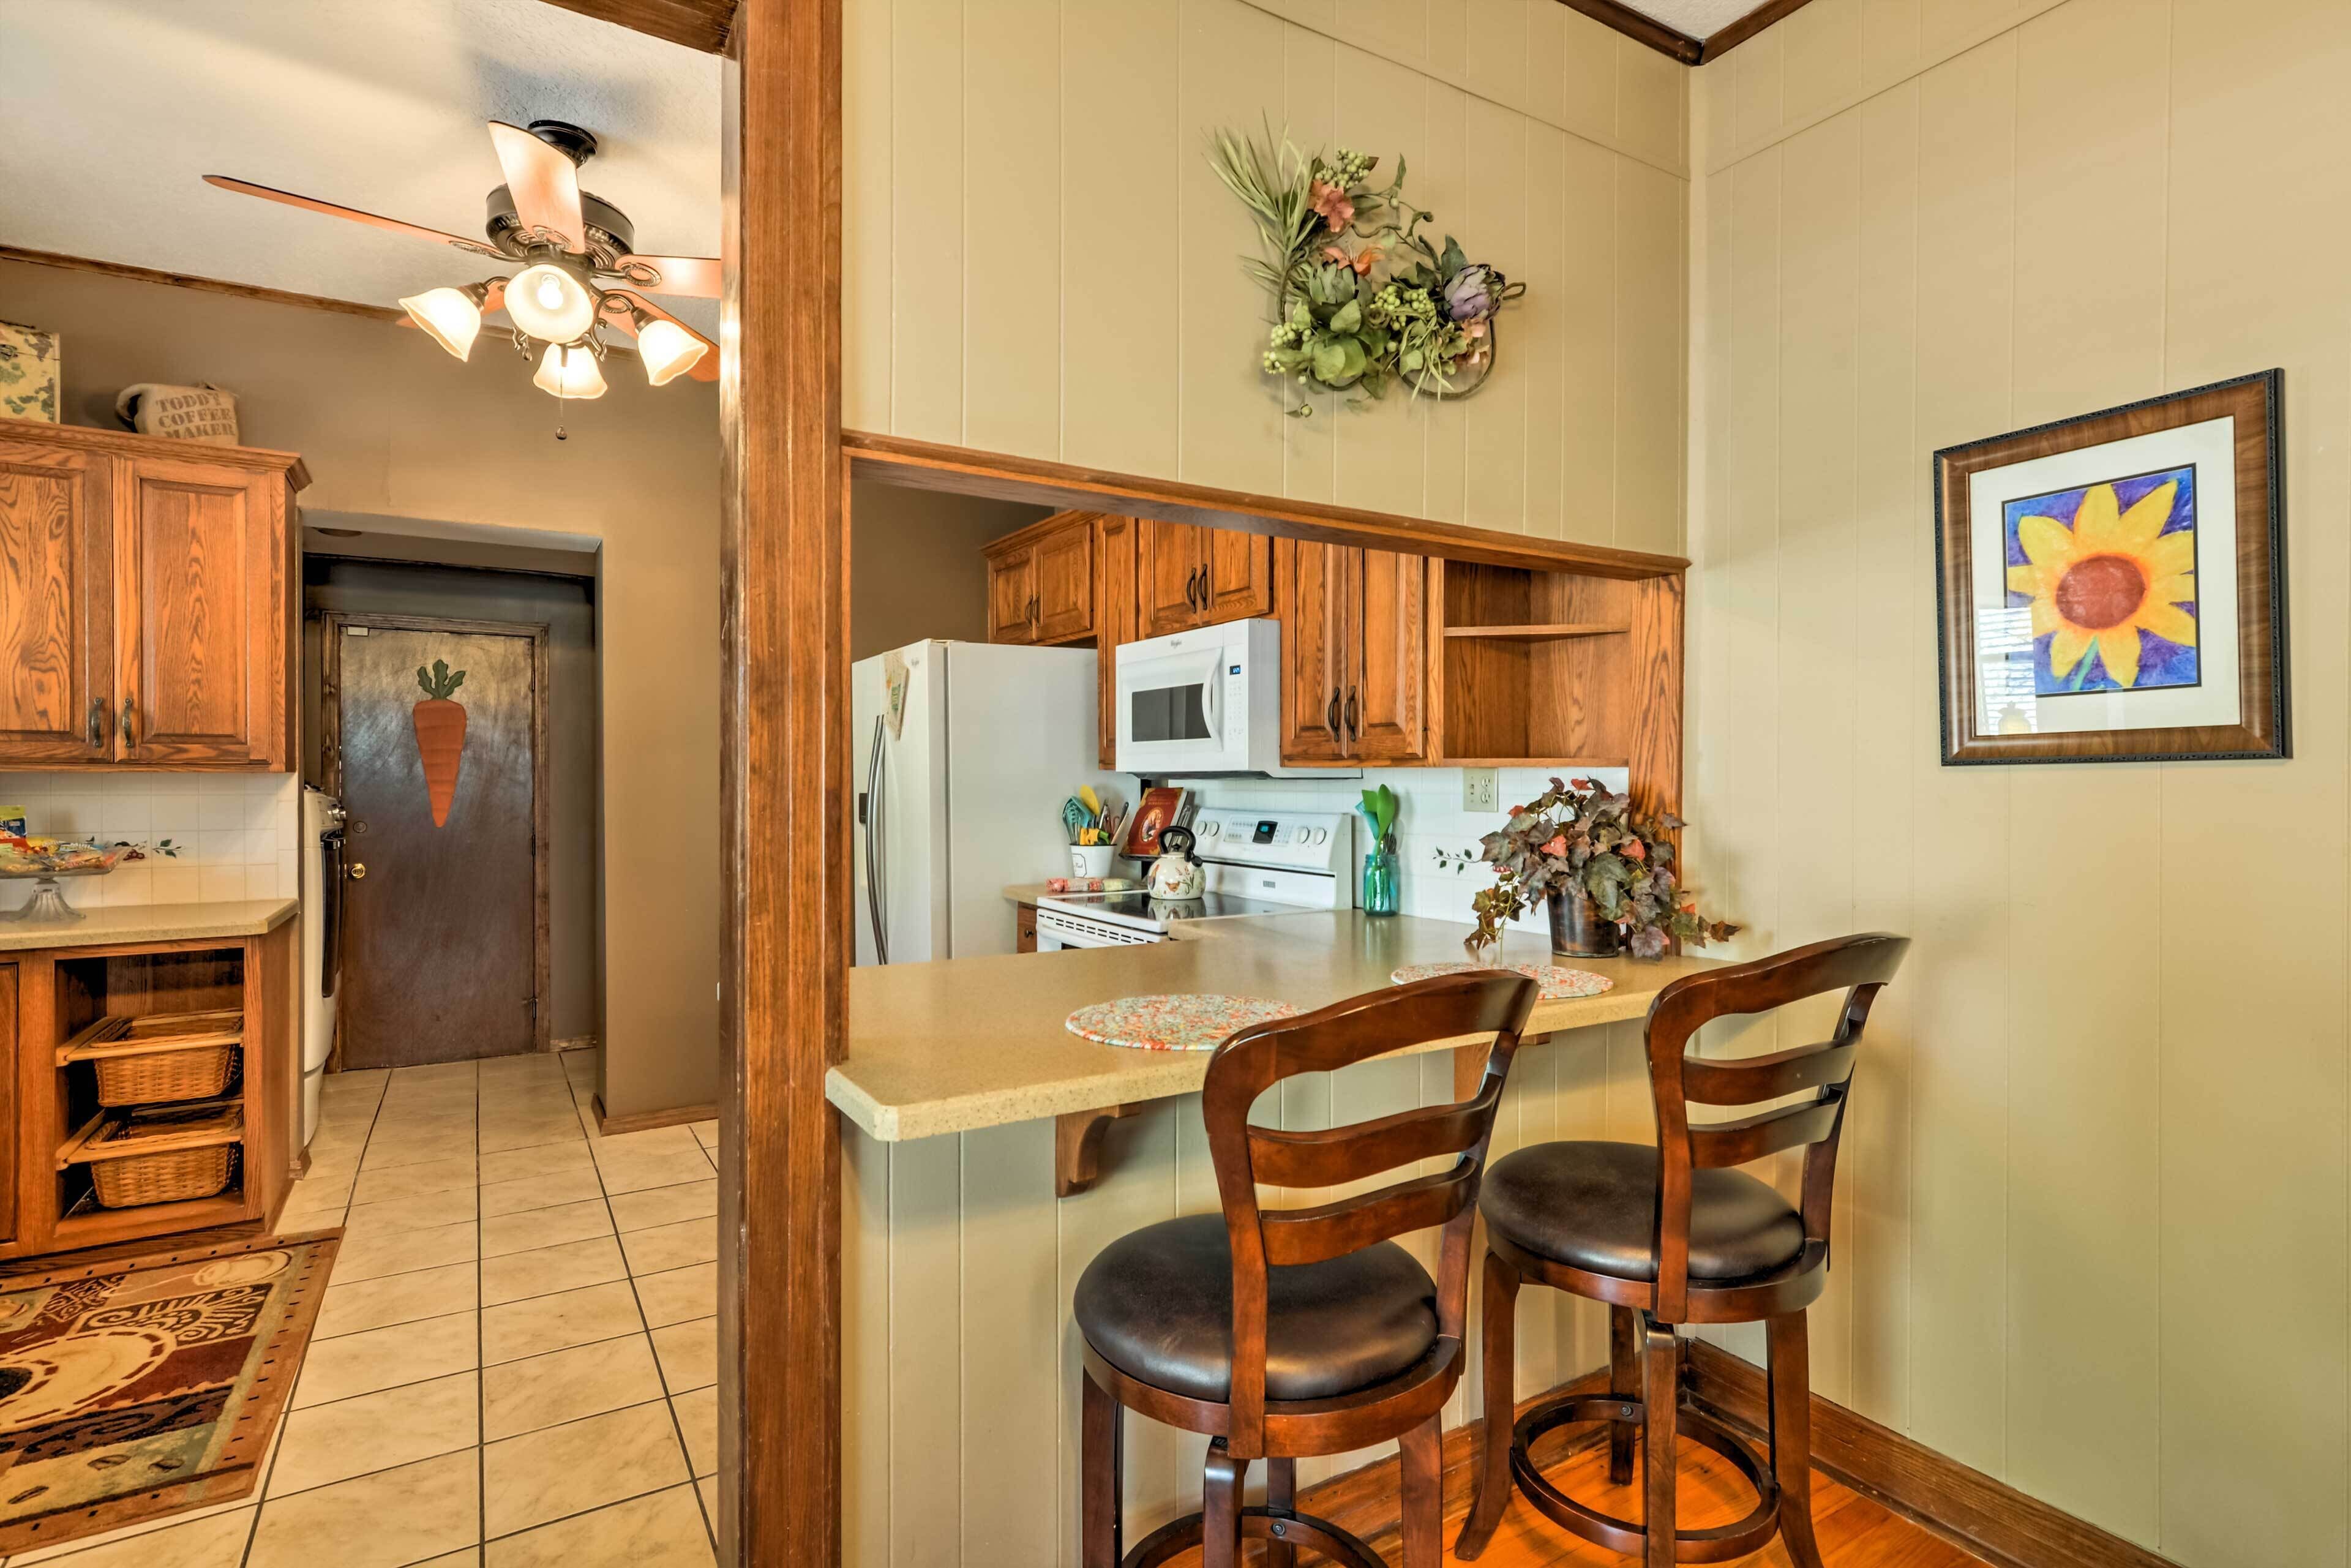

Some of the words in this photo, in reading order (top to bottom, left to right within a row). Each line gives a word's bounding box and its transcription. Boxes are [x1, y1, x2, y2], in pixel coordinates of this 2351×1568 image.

[156, 392, 221, 412] TODDY
[158, 408, 234, 427] COFFEE
[165, 423, 235, 438] MAKER
